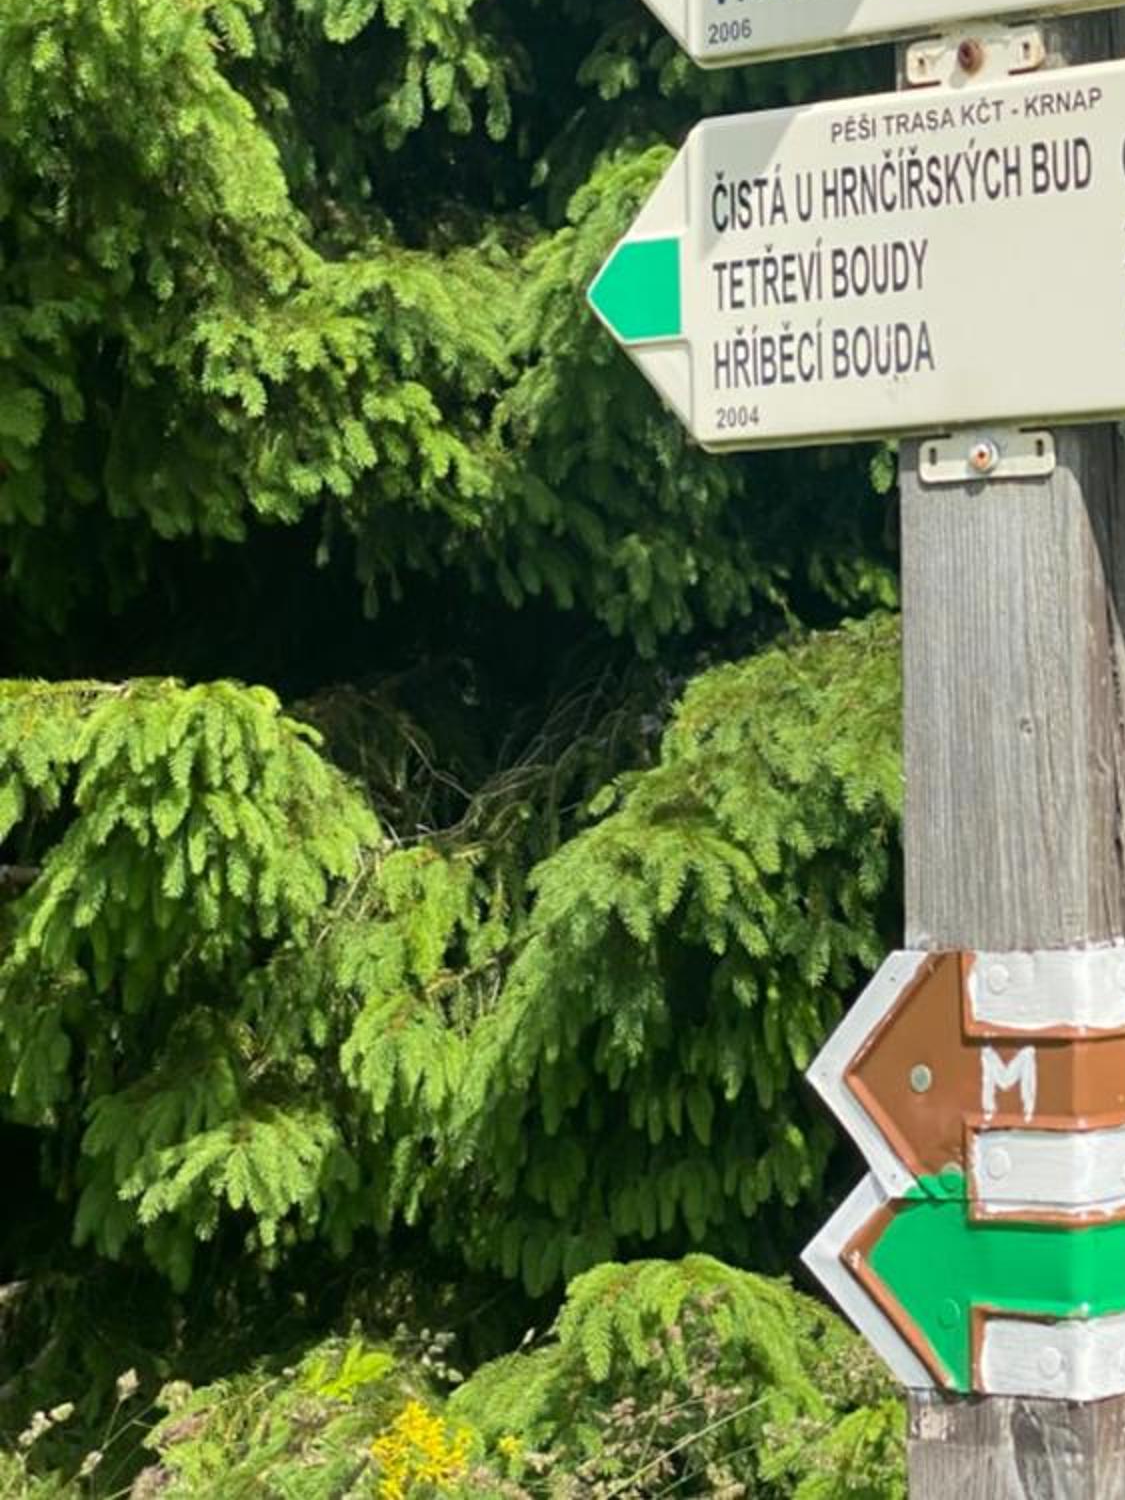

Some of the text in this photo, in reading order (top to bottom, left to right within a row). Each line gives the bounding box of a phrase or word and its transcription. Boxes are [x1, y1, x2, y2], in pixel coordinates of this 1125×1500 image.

[707, 18, 752, 45] 2006
[883, 106, 956, 134] TRASA
[960, 97, 1005, 126] KČT
[1023, 86, 1102, 117] KRNAP
[711, 163, 788, 234] ČISTÁ
[796, 172, 814, 223] U
[821, 138, 1021, 220] HRNČÍŘSKÝCH
[1032, 136, 1092, 195] BUD
[713, 237, 822, 311] TETŘEVÍ
[831, 238, 928, 298] BOUDY
[713, 317, 823, 389] HŘÍBĚCÍ
[832, 320, 935, 379] BOUDA
[716, 405, 759, 430] 2004
[981, 1044, 1037, 1123] M
